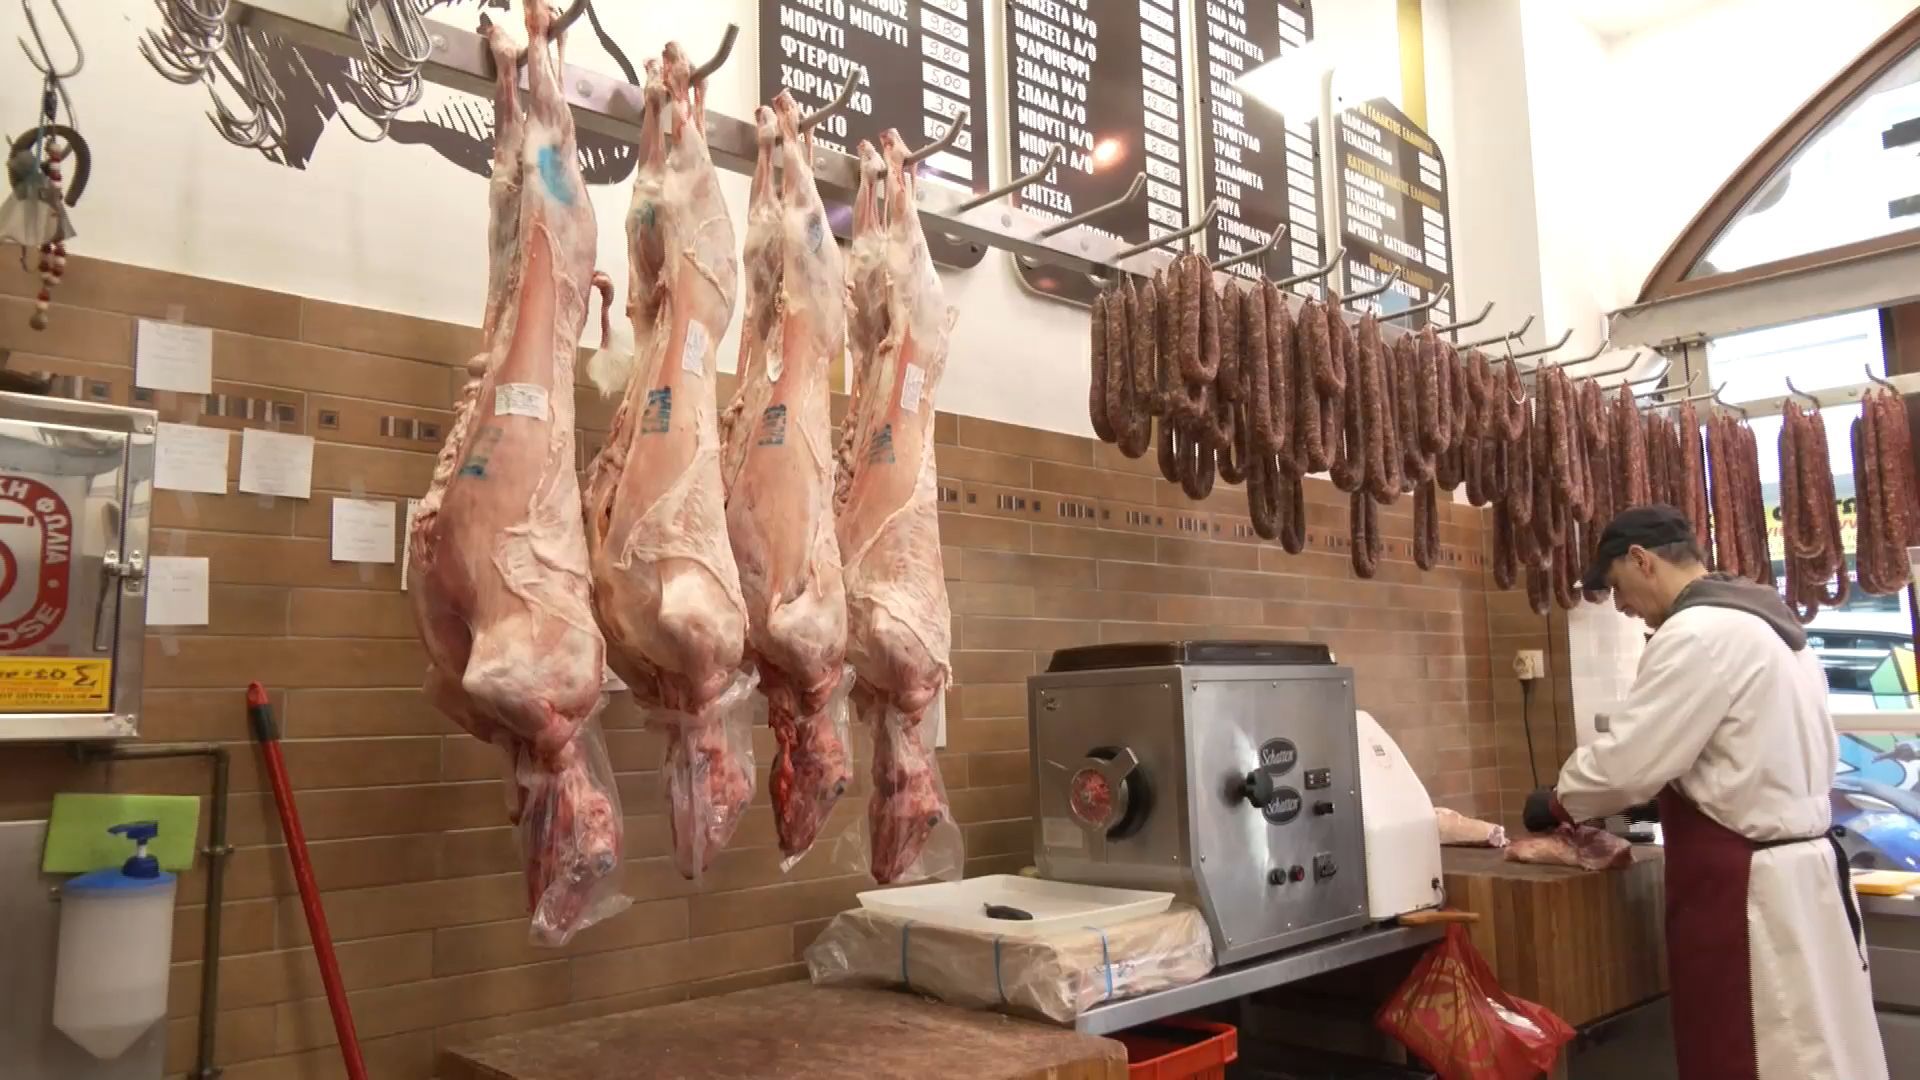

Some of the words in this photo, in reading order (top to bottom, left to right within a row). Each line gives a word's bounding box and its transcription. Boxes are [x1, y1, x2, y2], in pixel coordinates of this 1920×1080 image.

[780, 4, 845, 49] ΜΠΟΥΤΙ
[850, 5, 909, 48] ΜΠΟΥΤΙ
[1073, 36, 1098, 62] Α/Ο
[781, 64, 873, 115] ΧΩΡΙΑΤΚΟ
[1016, 56, 1060, 91] ΣΠΑΛΑ
[1061, 76, 1087, 102] Μ/Ο
[1017, 80, 1060, 114] ΣΠΑΛΑ
[1062, 100, 1087, 125] Α/Ο
[1018, 104, 1066, 141] ΜΠΟΥΤΙ
[1068, 125, 1094, 151] Μ/Ο
[1070, 150, 1094, 175] Α/Ο
[1215, 176, 1241, 201] ΧΤΕΝΙ
